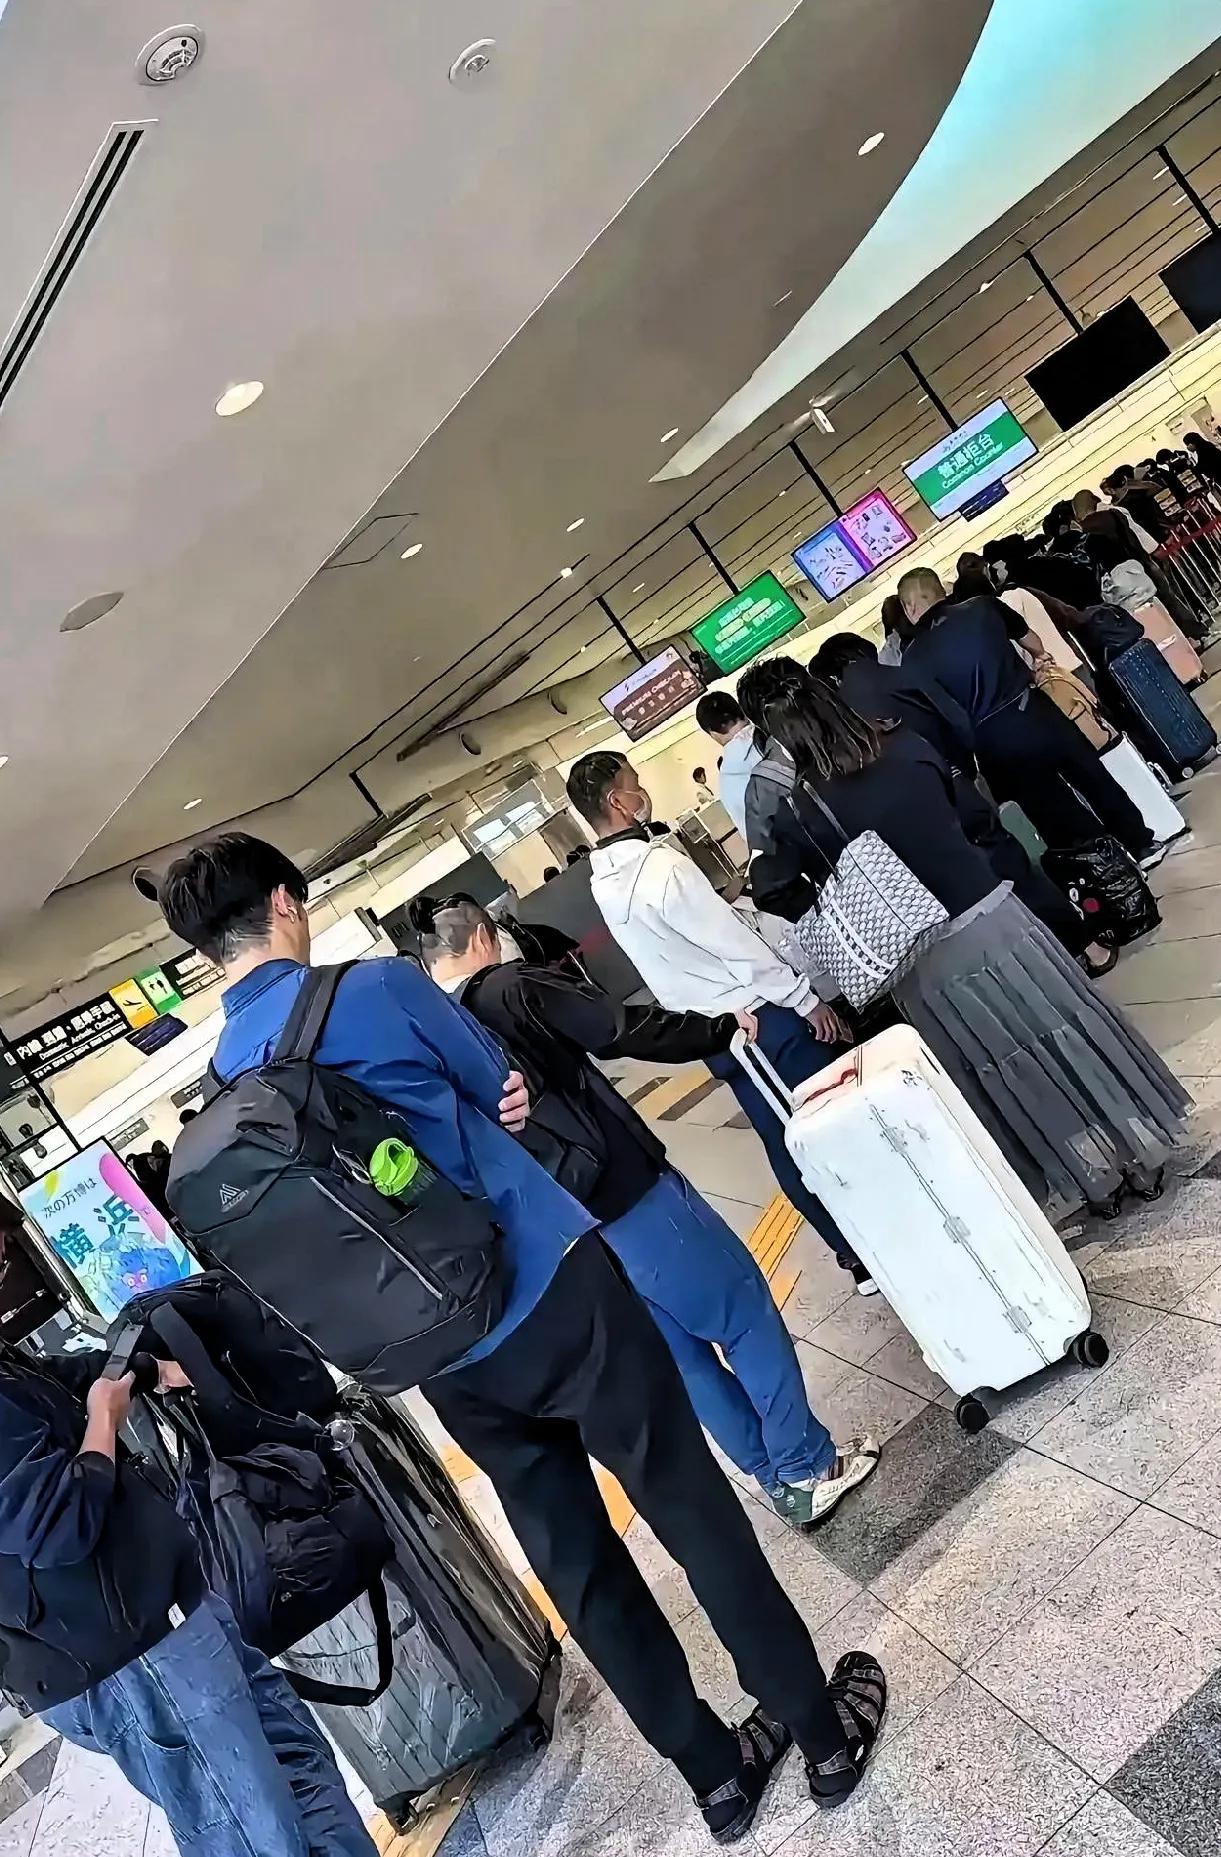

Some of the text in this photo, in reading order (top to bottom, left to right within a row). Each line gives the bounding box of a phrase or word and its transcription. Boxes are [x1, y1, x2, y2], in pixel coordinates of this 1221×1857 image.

[42, 1178, 98, 1220] 次の万博は
[48, 1194, 140, 1270] 横浜
